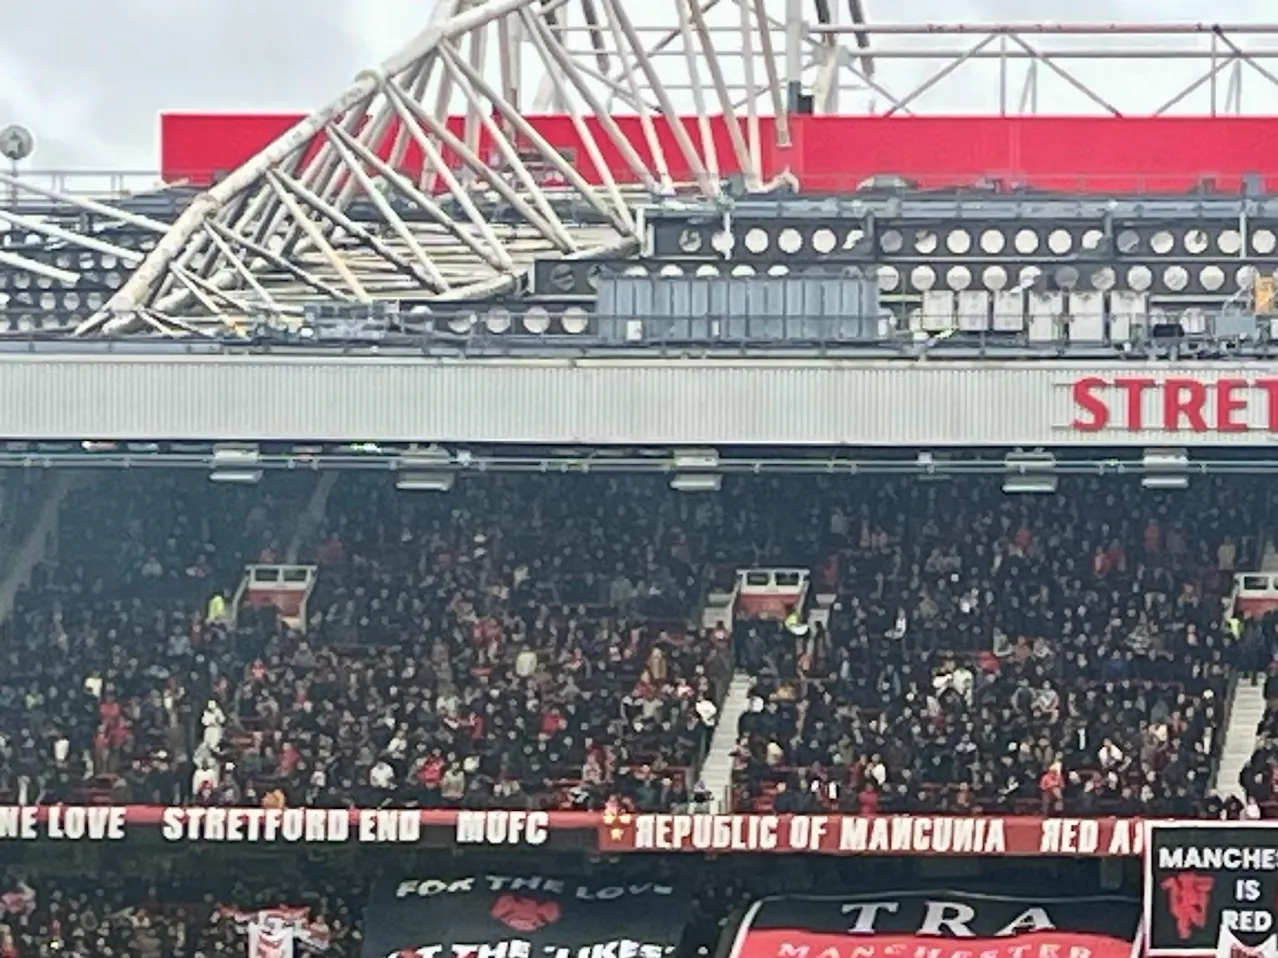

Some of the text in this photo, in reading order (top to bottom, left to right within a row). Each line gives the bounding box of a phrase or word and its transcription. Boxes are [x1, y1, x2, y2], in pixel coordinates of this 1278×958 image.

[48, 806, 125, 839] LOVE
[163, 808, 420, 842] STRETFORD END
[456, 811, 549, 844] MUFC
[789, 816, 828, 850] OF
[396, 875, 673, 899] FOR THE LOVE
[1235, 879, 1260, 901] IS
[841, 900, 1056, 938] TRA
[1221, 909, 1273, 932] RED
